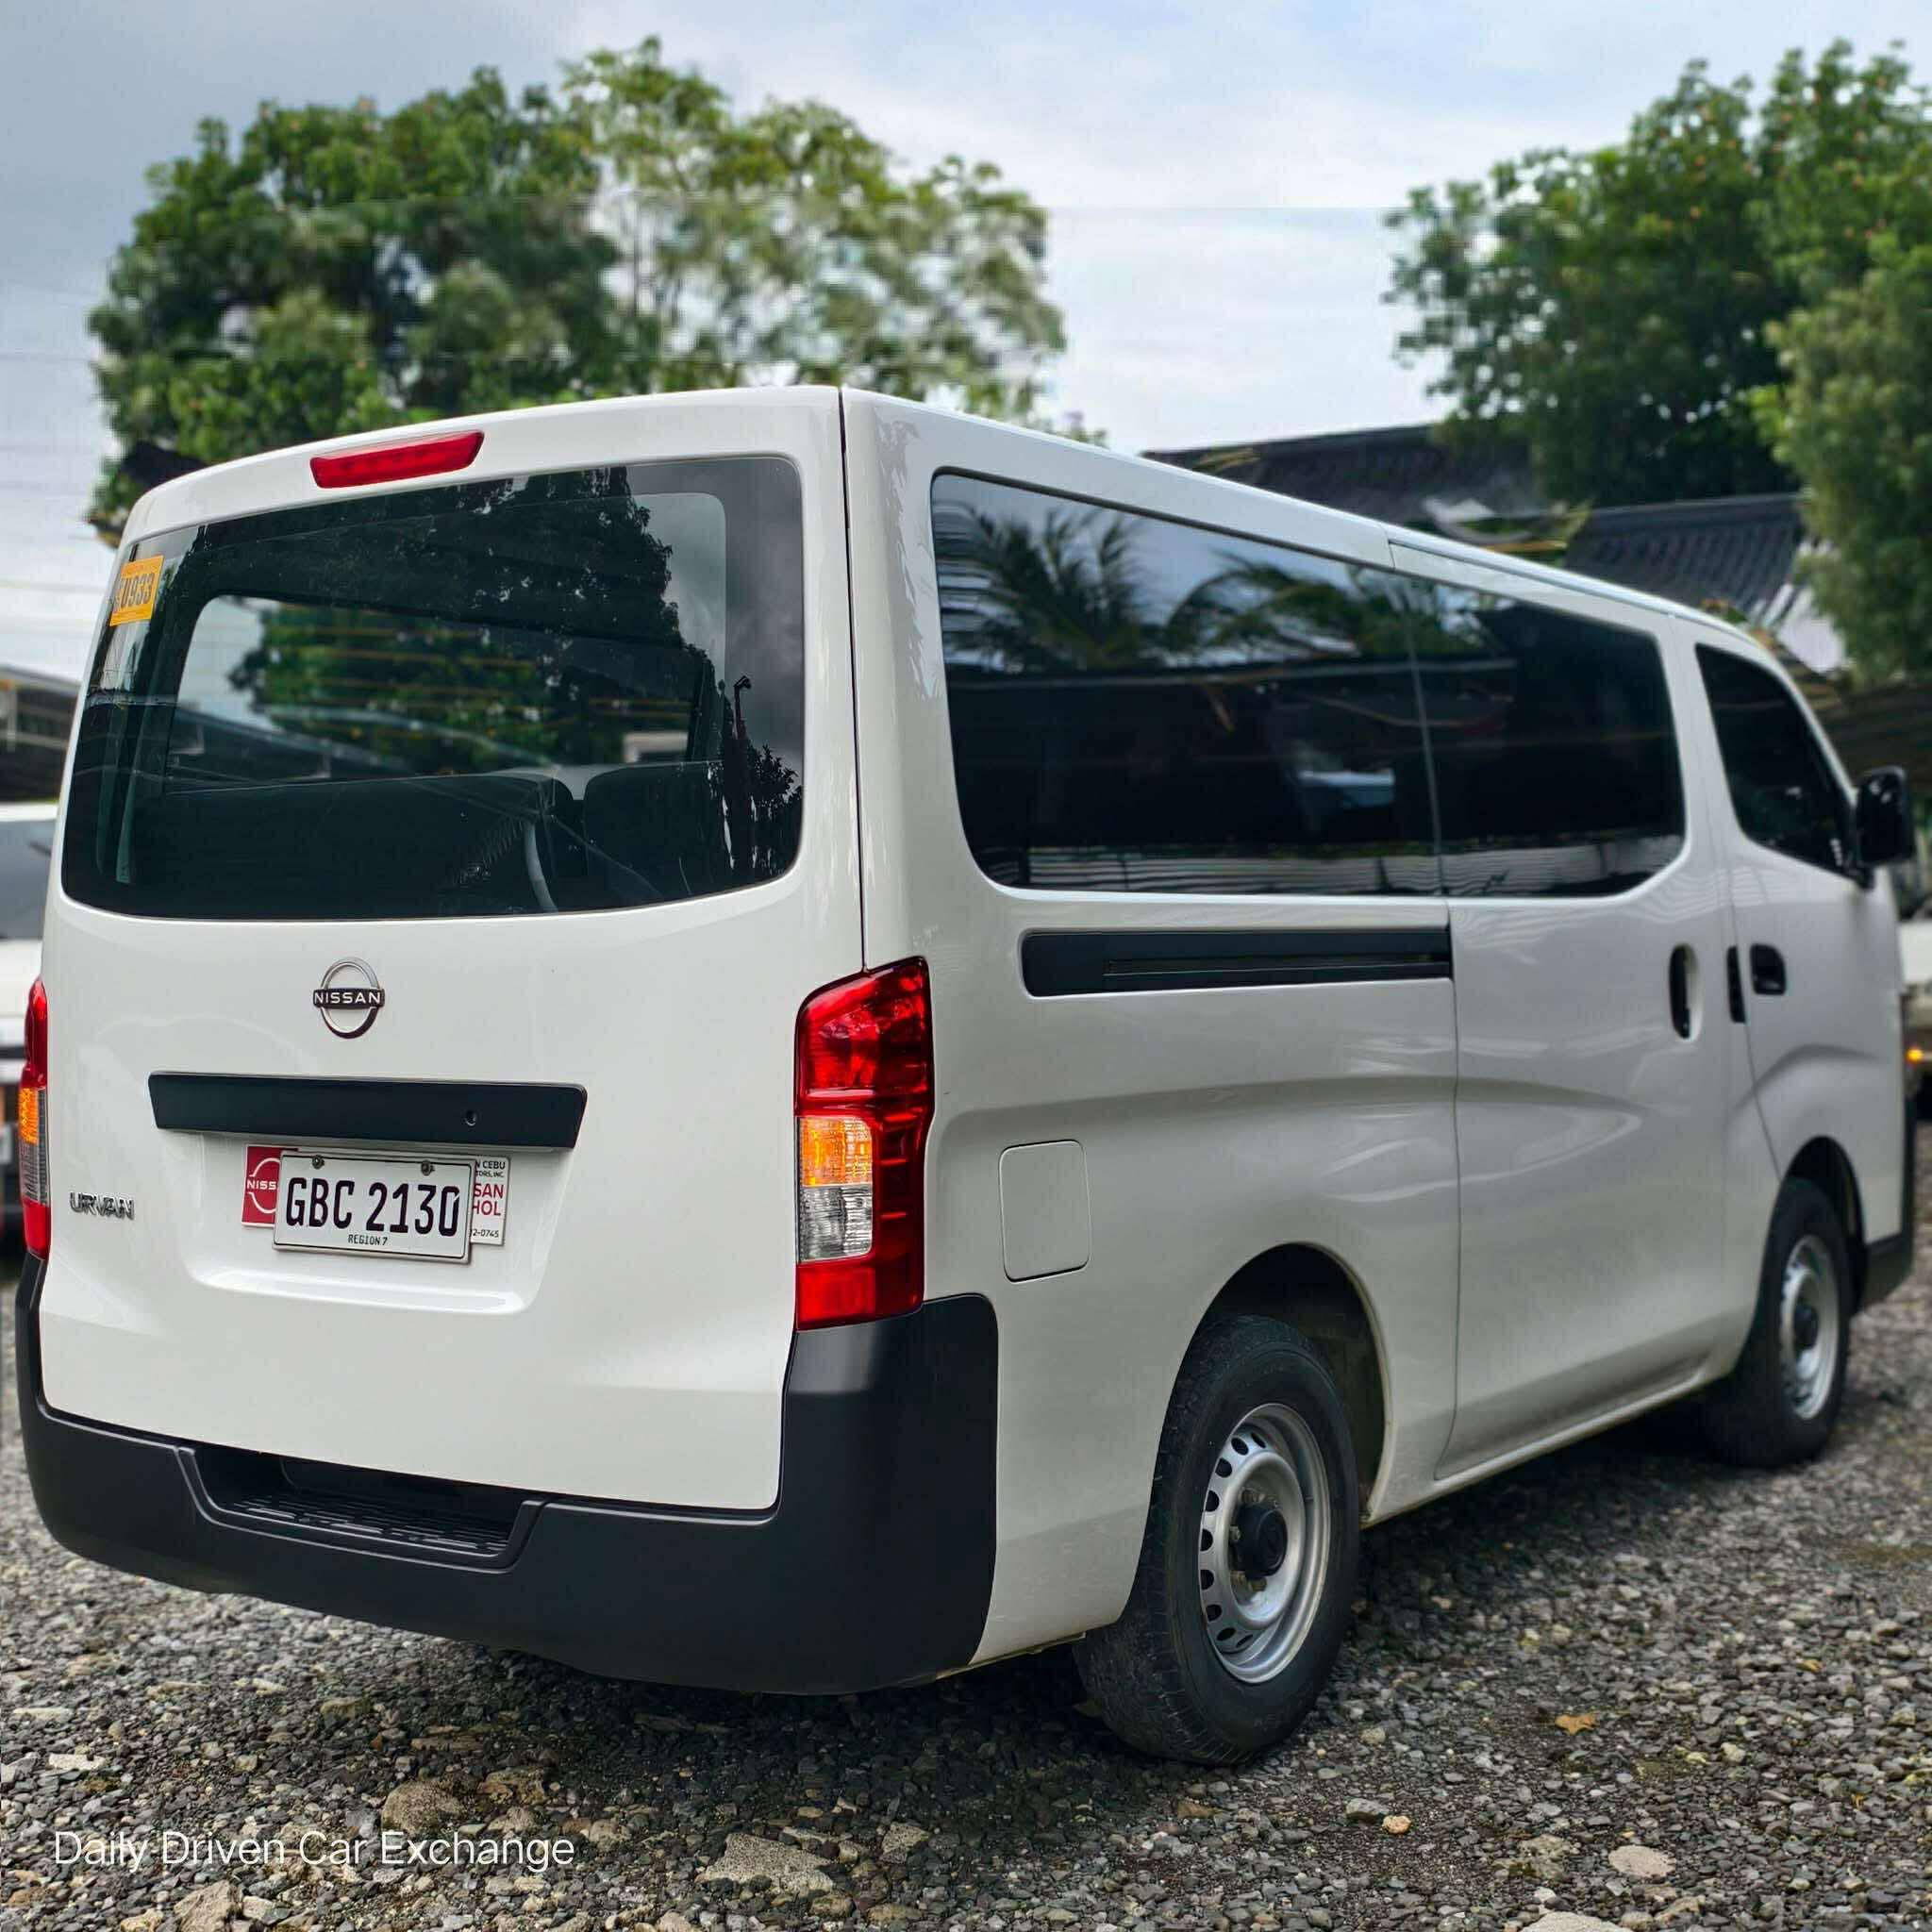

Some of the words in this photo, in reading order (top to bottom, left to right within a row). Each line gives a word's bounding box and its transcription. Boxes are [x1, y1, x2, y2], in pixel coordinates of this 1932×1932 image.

[314, 991, 380, 1005] NISSAN
[482, 1160, 506, 1170] CEBU
[69, 1191, 135, 1221] URVAN
[286, 1177, 356, 1228] GBC
[365, 1182, 460, 1237] 2130
[348, 1234, 381, 1245] REGION
[382, 1236, 388, 1245] 7
